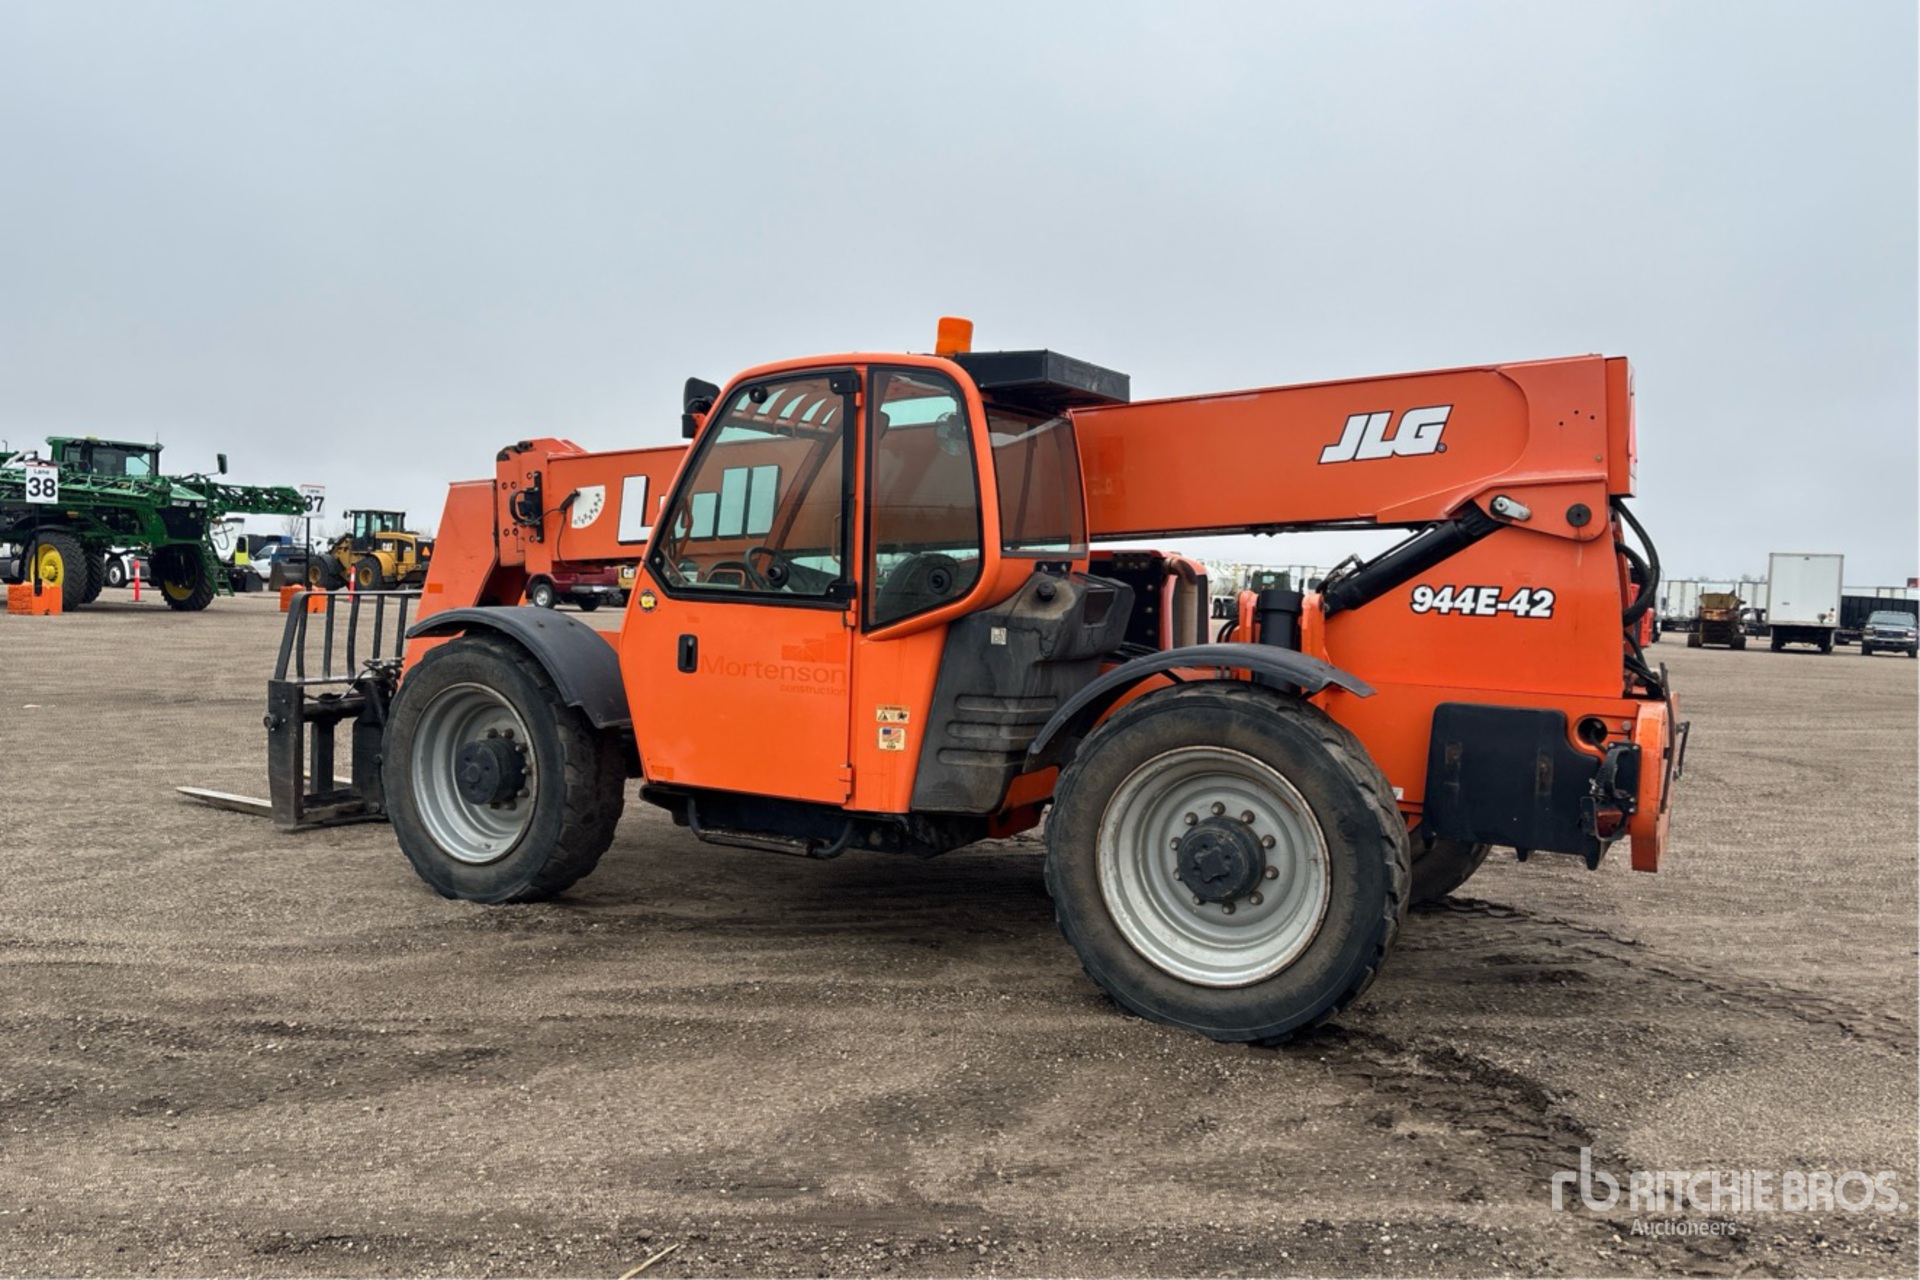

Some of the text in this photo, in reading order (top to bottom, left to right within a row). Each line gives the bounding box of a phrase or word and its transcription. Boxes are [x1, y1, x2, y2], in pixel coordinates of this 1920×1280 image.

[1319, 404, 1453, 464] JLG
[28, 477, 56, 498] 38
[1411, 585, 1555, 618] 944E-42
[701, 654, 847, 685] Mortenson
[780, 684, 847, 697] construction
